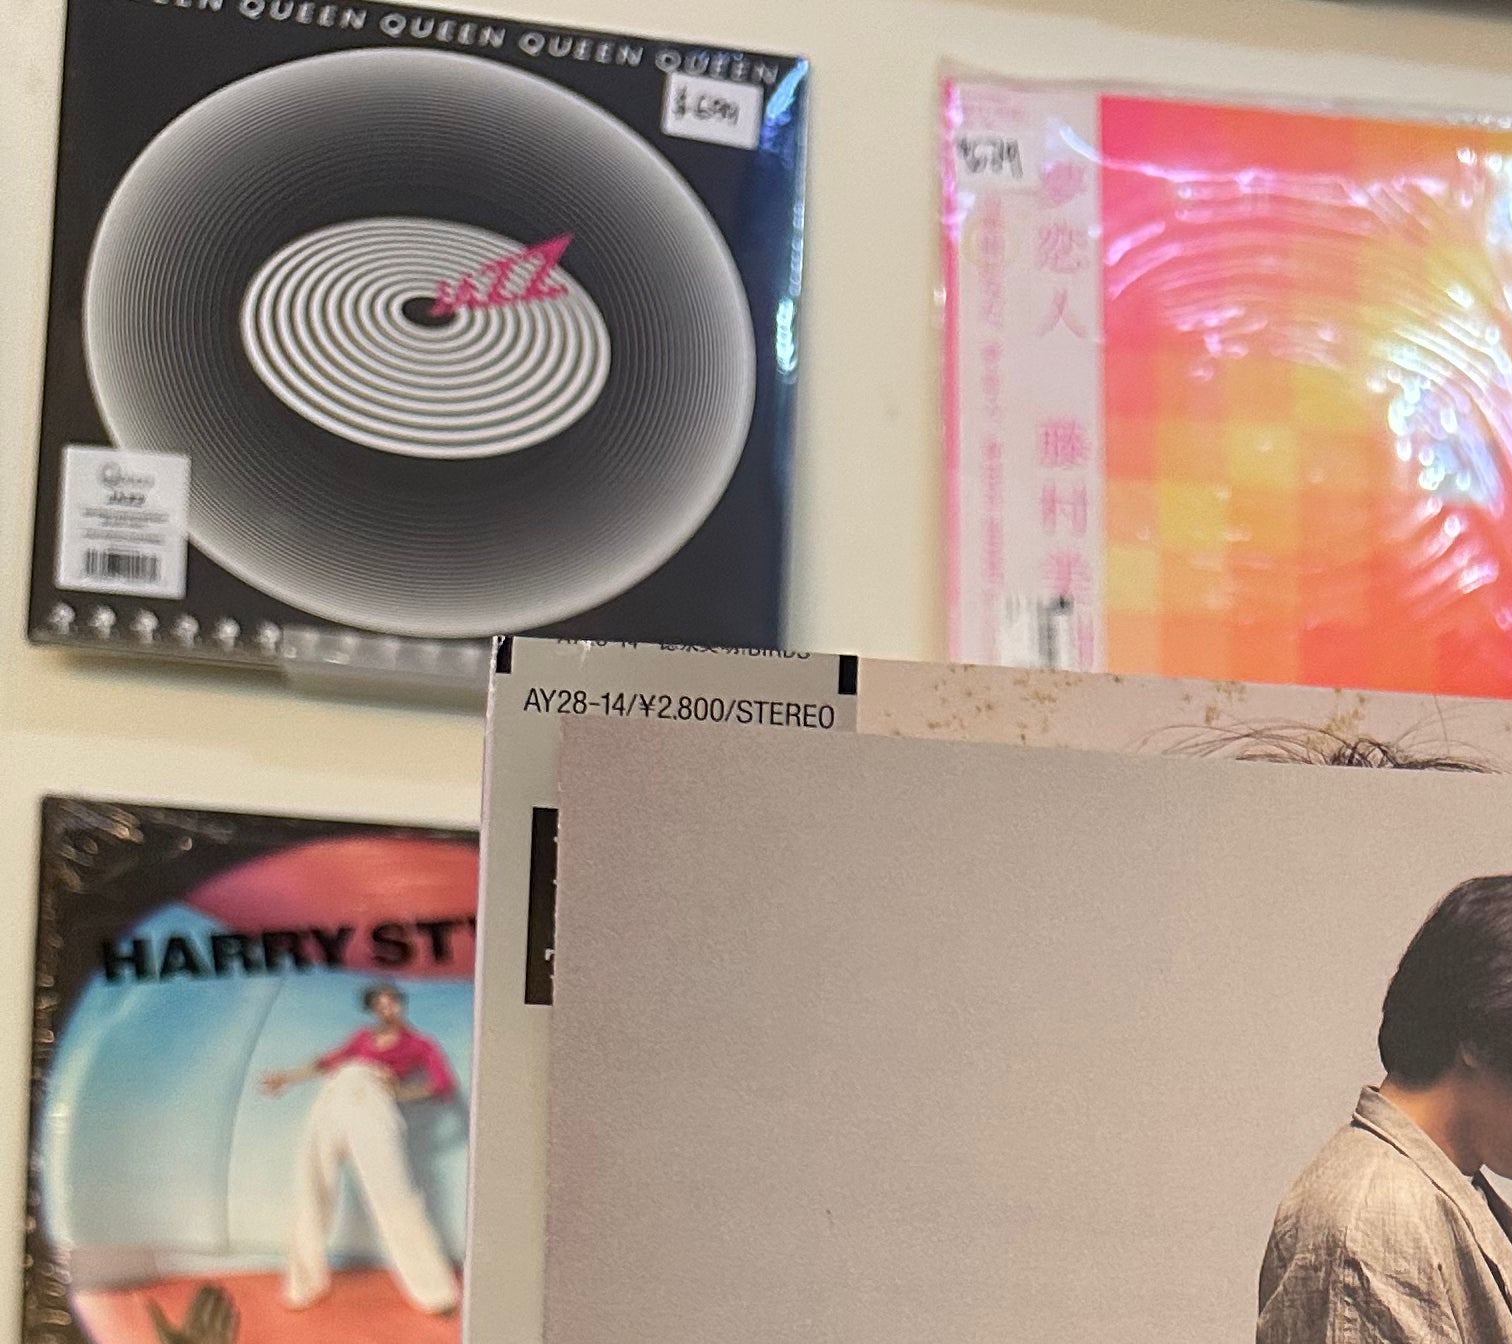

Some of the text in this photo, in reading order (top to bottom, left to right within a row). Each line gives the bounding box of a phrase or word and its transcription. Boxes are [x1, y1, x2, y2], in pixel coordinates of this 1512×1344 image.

[239, 0, 779, 85] QUEEN QUEEN QUEEN QUEEN
[100, 924, 352, 984] HARRY
